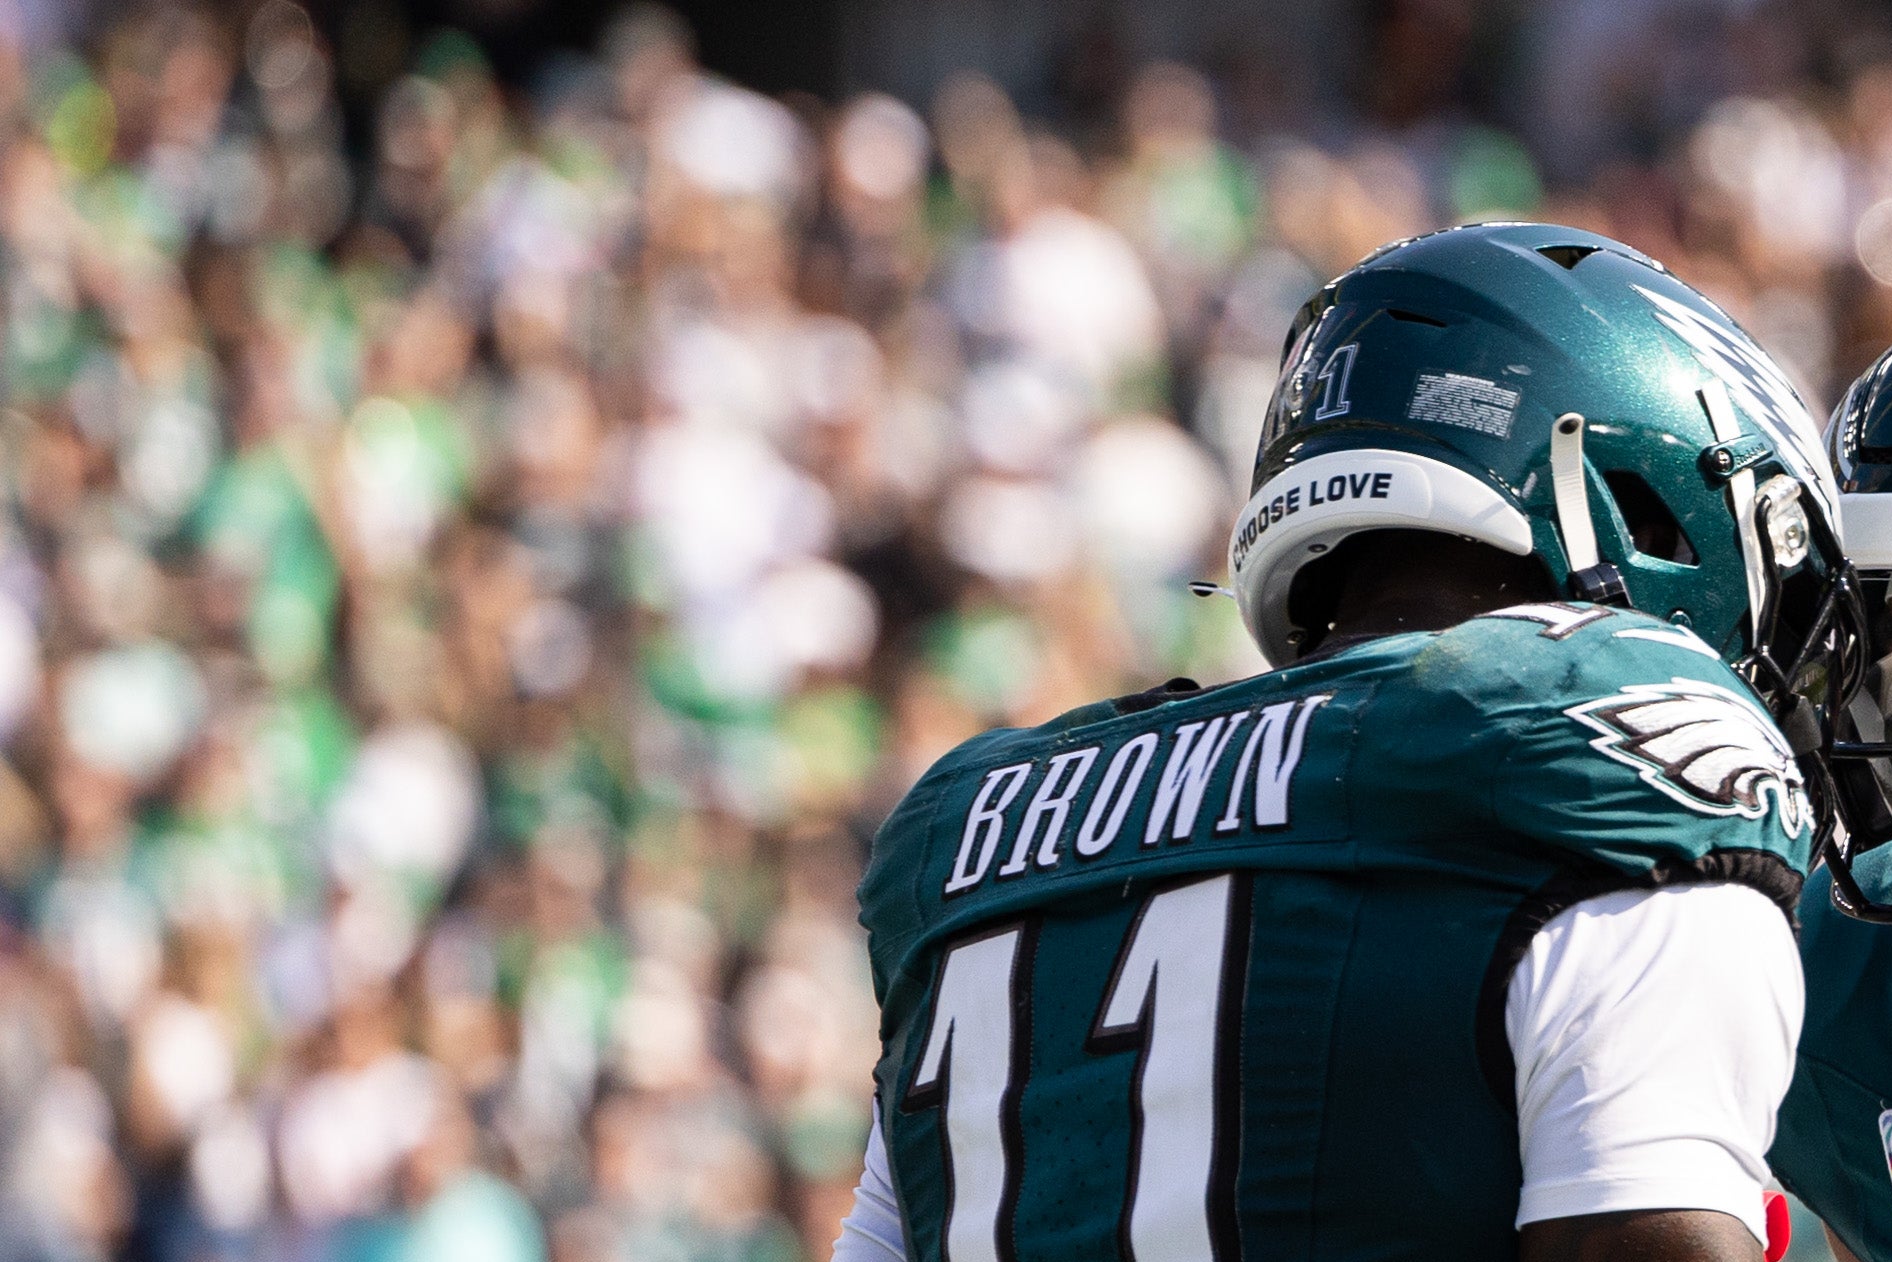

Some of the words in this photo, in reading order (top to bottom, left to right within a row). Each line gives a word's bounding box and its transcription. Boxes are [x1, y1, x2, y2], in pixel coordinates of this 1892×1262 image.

[1233, 486, 1301, 572] CHOOSE
[1309, 473, 1393, 507] LOVE
[943, 694, 1330, 897] BROWN
